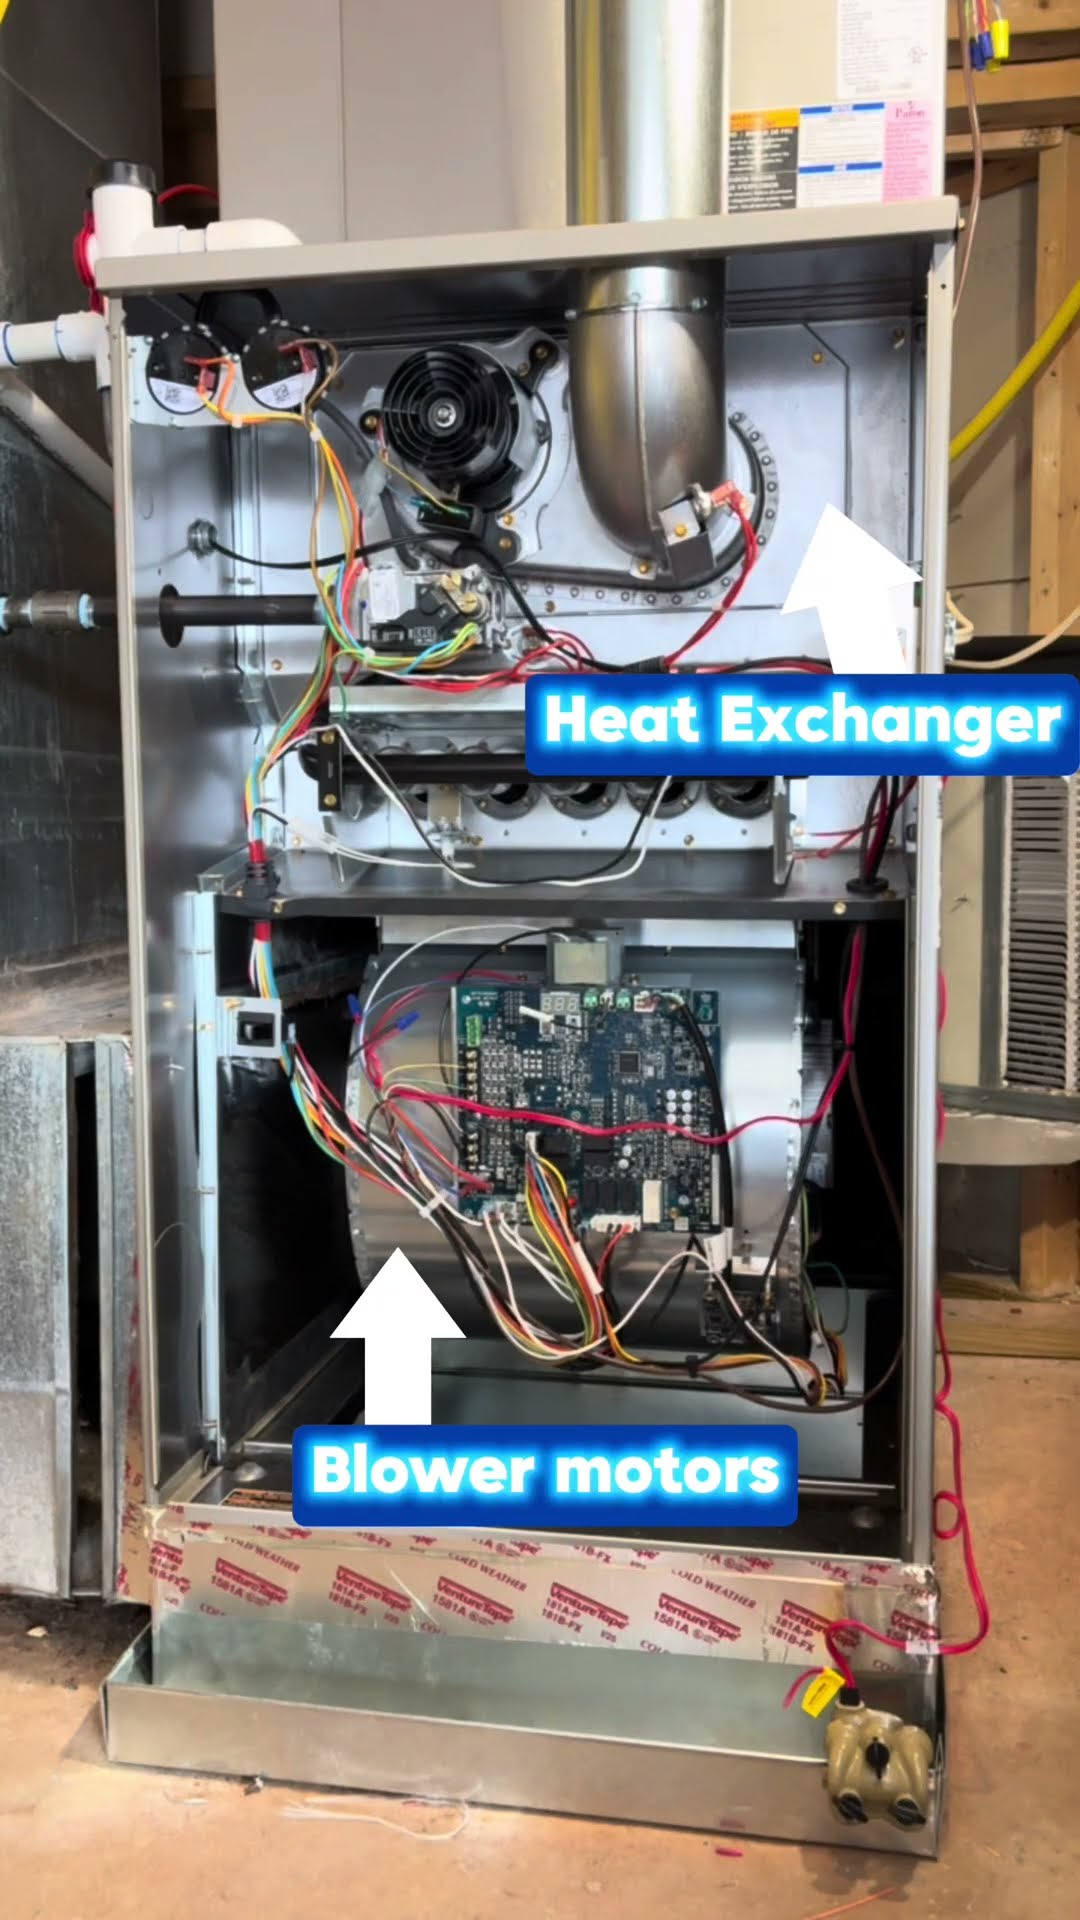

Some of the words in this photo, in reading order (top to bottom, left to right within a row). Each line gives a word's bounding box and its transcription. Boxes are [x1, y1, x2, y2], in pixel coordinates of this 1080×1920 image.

[254, 1546, 300, 1574] WEATHER
[210, 1575, 244, 1598] 1581A
[215, 1557, 288, 1604] VentureTape
[336, 1565, 412, 1613] VentureTape
[480, 1563, 527, 1592] WEATHER
[432, 1593, 467, 1616] 1581A
[437, 1575, 515, 1623] VentureTape
[546, 1597, 581, 1618] 181A-P
[550, 1582, 630, 1630] VentureTape
[705, 1578, 757, 1609] WEATHER
[542, 1608, 583, 1633] 181B-FX
[654, 1611, 689, 1635] 1581A
[658, 1592, 741, 1642] VentureTape
[776, 1614, 814, 1638] 181A-P
[769, 1625, 816, 1654] 181B-FX
